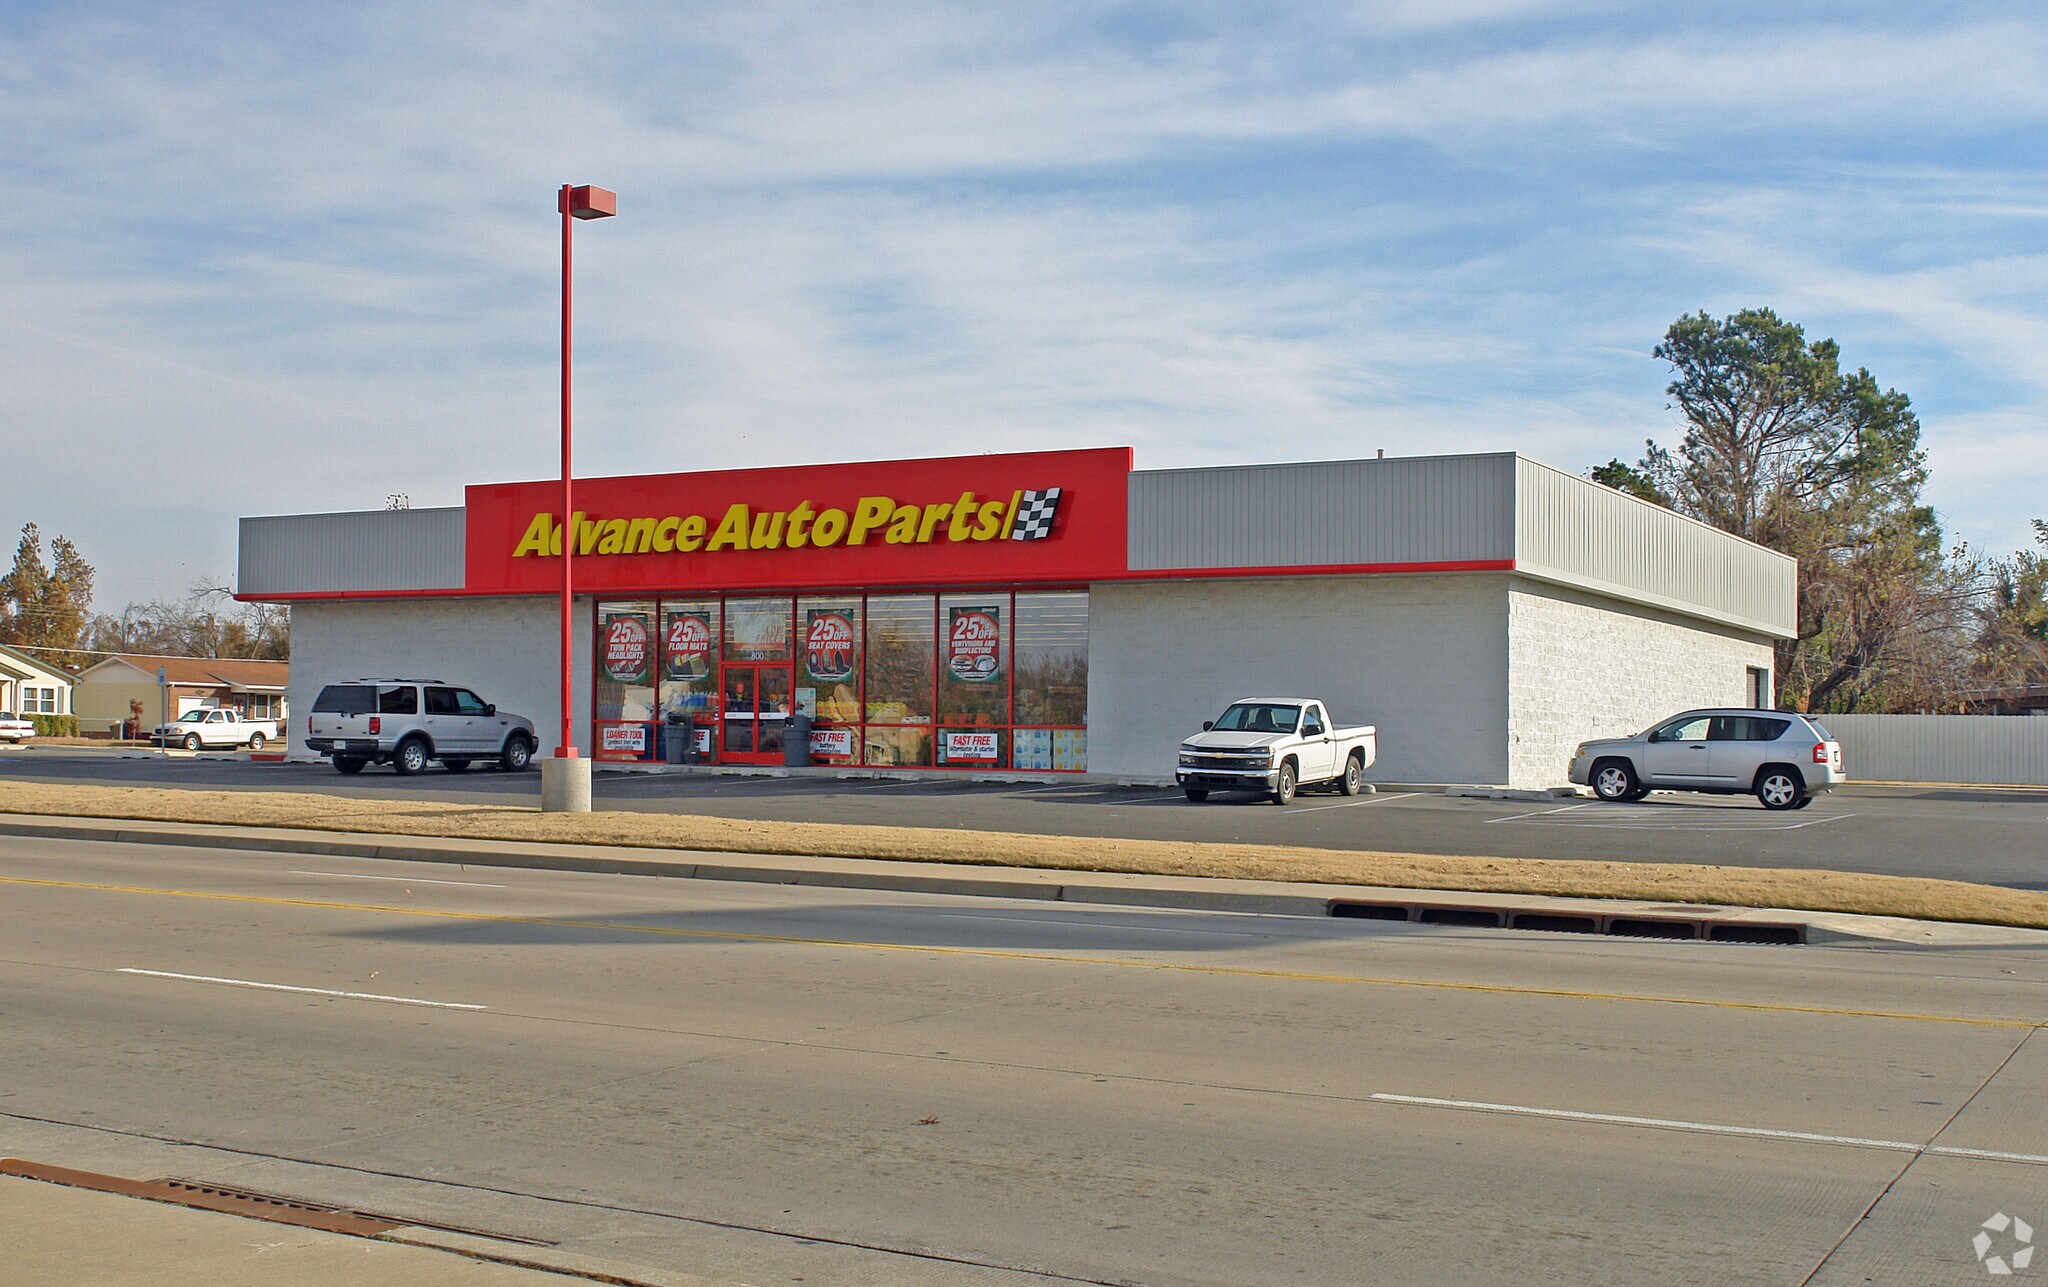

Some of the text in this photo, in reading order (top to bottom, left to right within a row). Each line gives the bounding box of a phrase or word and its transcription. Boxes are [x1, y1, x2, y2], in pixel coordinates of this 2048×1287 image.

[512, 511, 706, 557] Advance
[706, 501, 848, 551] Auto
[630, 633, 646, 643] OFF
[692, 633, 707, 642] OFF
[756, 634, 784, 642] PRICES
[834, 631, 848, 640] OFF
[978, 629, 994, 638] OFF
[610, 644, 624, 652] TWIN
[669, 642, 708, 650] FLOOR MATS
[808, 642, 824, 650] SEAT
[608, 652, 644, 660] HEADLIGHTS
[751, 652, 764, 660] 800
[606, 730, 644, 740] LOANER TOOL
[810, 732, 846, 742] FAST FREE
[953, 736, 991, 746] FAST FREE
